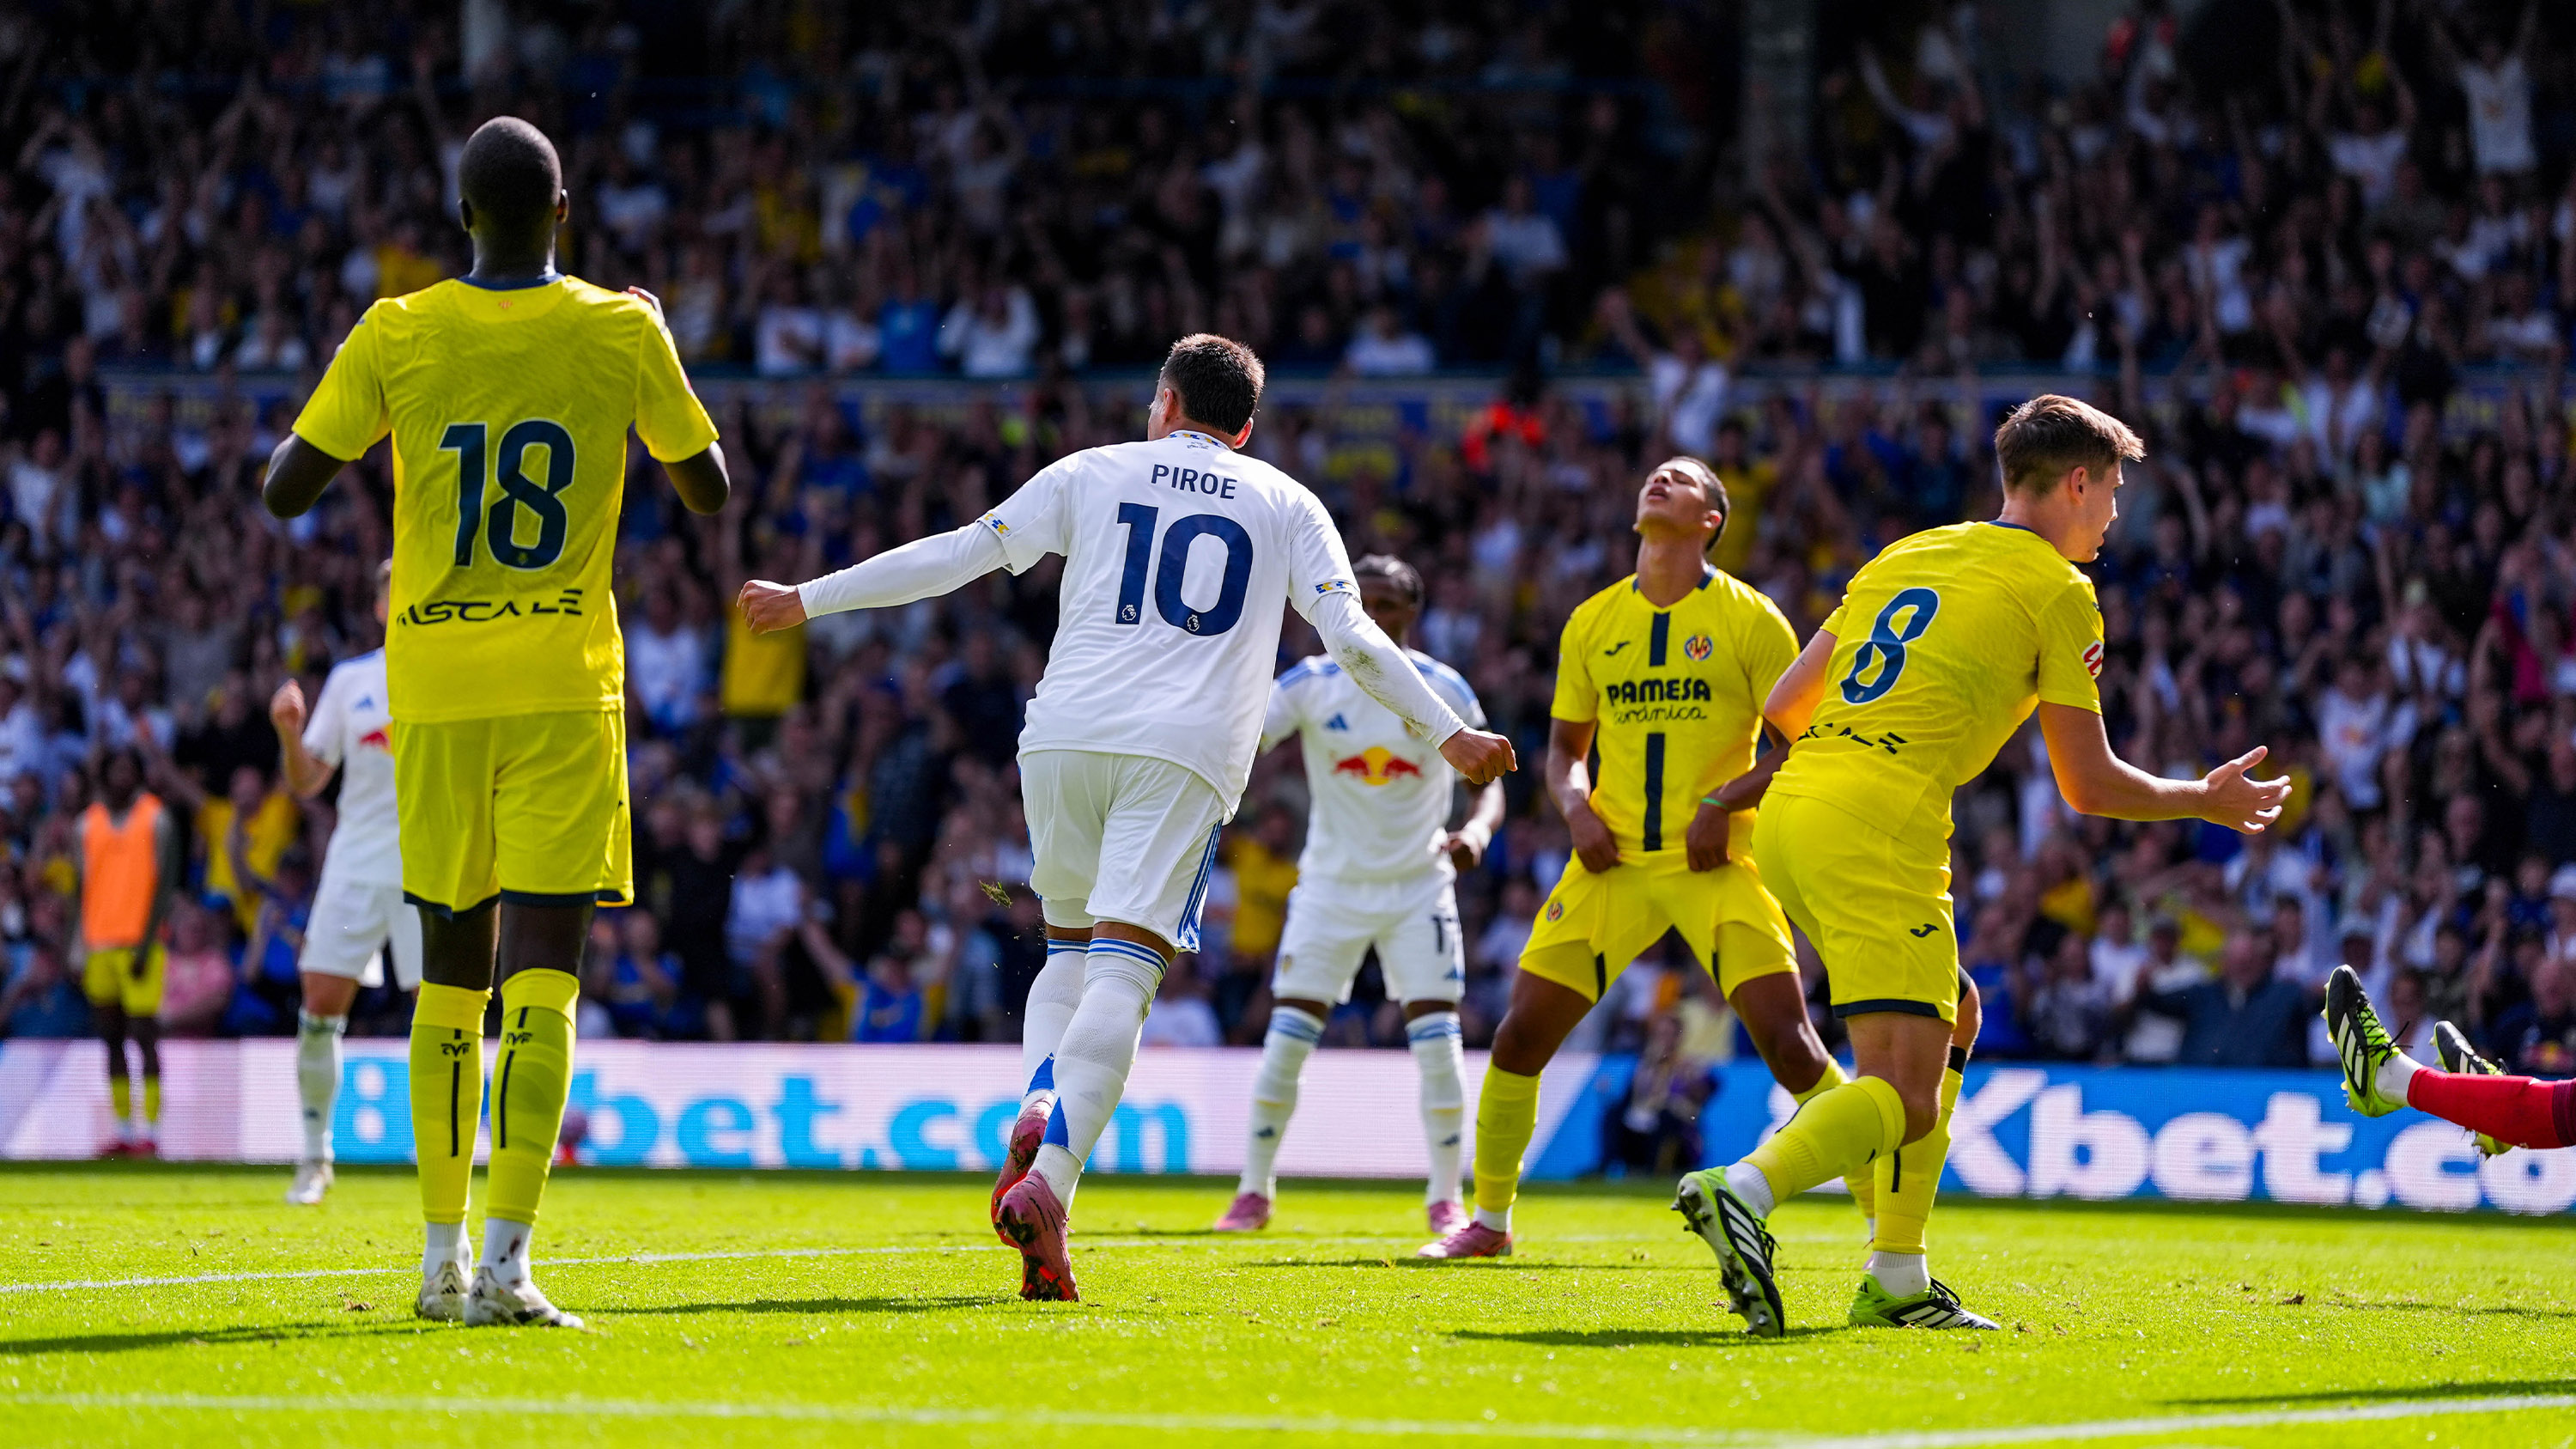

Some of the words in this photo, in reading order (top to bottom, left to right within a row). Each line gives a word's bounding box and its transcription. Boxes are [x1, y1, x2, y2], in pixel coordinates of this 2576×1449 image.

[437, 417, 576, 572] 18
[1151, 464, 1237, 500] PIROE
[1115, 502, 1254, 636] 10
[1607, 678, 1710, 707] PAMESA
[1839, 588, 1940, 705] 8
